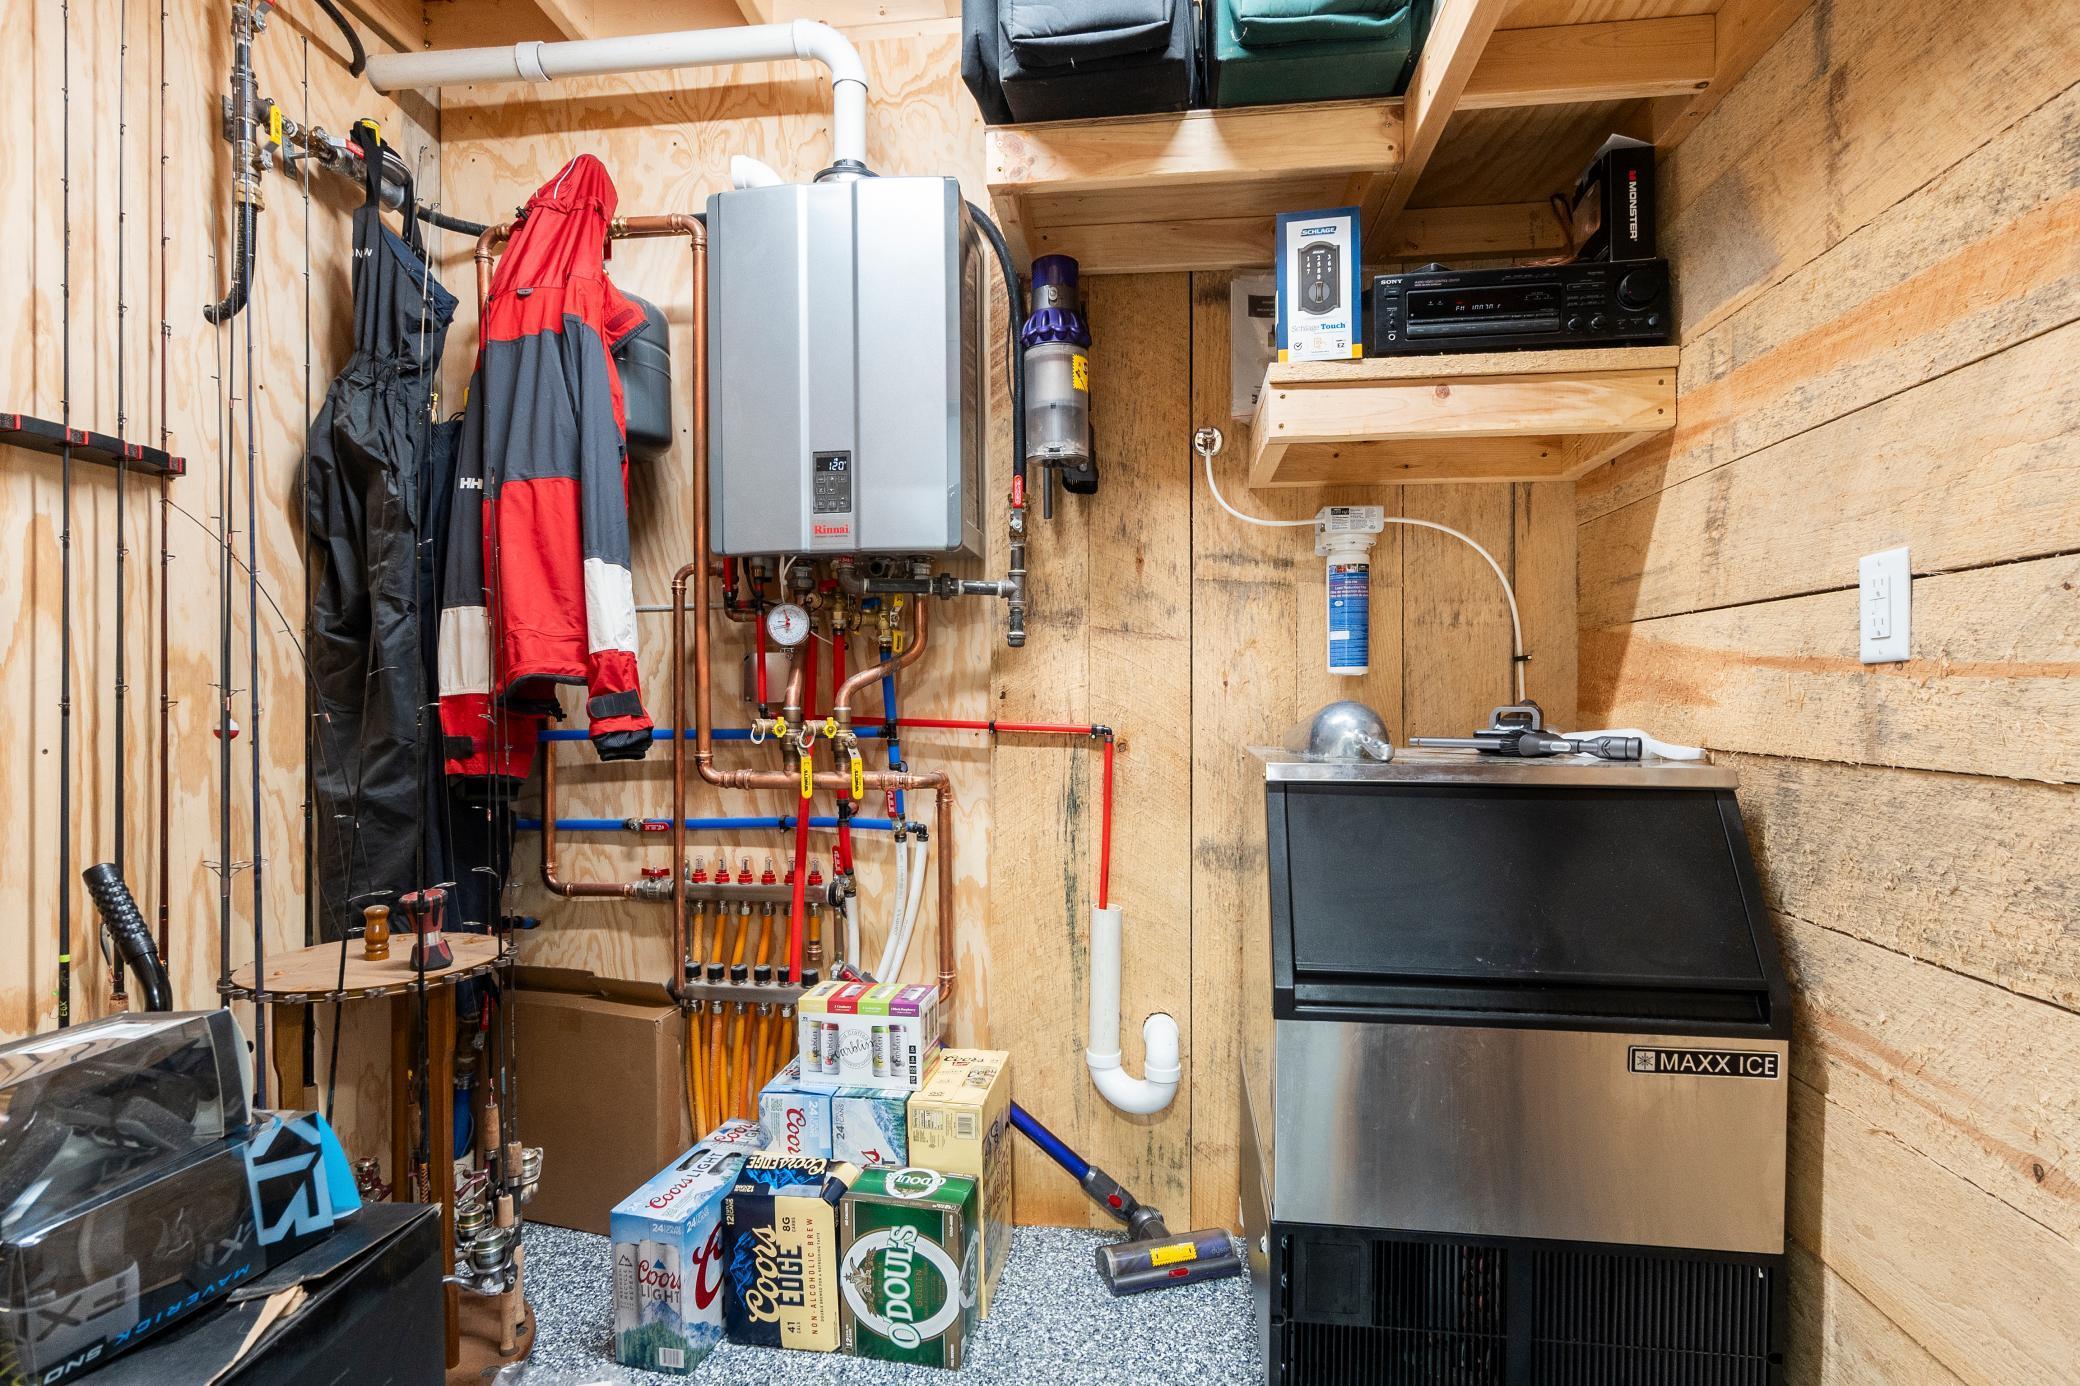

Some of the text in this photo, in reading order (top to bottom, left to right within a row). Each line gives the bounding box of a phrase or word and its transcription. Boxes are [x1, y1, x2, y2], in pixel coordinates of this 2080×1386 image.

[1628, 181, 1638, 240] MONSTER
[1301, 226, 1336, 236] SCHLAGE
[460, 477, 483, 489] HH
[814, 524, 849, 535] Rinnai
[1660, 1052, 1775, 1075] MAXX ICE
[786, 1108, 807, 1155] Coor
[836, 1126, 845, 1140] 24
[746, 1156, 828, 1176] Coors EDGE
[649, 1152, 723, 1210] Coors LIGHT
[652, 1224, 664, 1233] 24
[686, 1217, 696, 1234] 24
[726, 1216, 735, 1226] 12
[782, 1216, 790, 1232] 8G
[638, 1260, 682, 1290] Coors
[745, 1224, 780, 1323] Coors
[776, 1244, 805, 1307] EDGE
[806, 1218, 819, 1335] NON-ALCOHOLIC BREW
[641, 1284, 680, 1303] LIGHT
[882, 1224, 921, 1350] O'DOUL'S
[114, 1263, 250, 1347] MAVERICK
[787, 1321, 795, 1334] 41
[845, 1337, 853, 1348] 12
